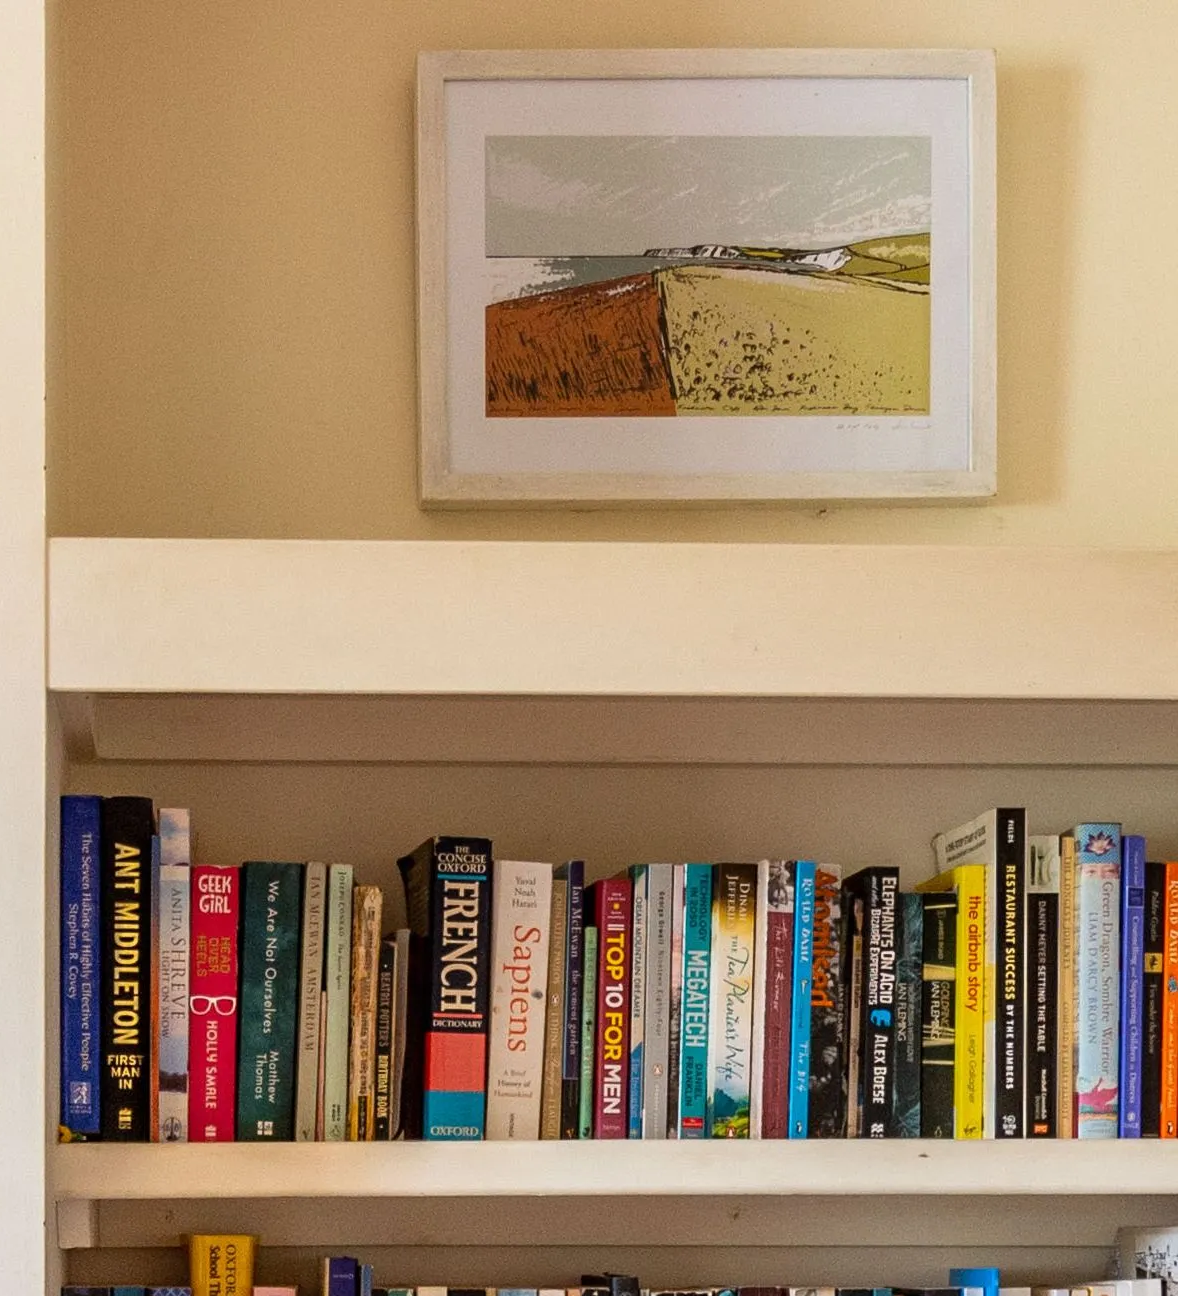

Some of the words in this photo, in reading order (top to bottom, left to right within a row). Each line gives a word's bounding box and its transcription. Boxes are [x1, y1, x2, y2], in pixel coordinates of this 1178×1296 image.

[114, 843, 141, 894] ANT
[437, 852, 487, 864] CONCISE
[437, 863, 487, 874] OXFORD
[198, 875, 232, 894] GEEK
[268, 880, 280, 903] We
[1102, 880, 1113, 918] Green
[171, 888, 182, 932] ANITA
[267, 910, 278, 933] Are
[880, 876, 896, 948] ELEPHANTS
[969, 895, 982, 921] the
[1005, 865, 1017, 944] RESTAURANT
[67, 903, 79, 949] Stephen
[195, 935, 207, 977] HEELS
[208, 937, 219, 973] OVER
[219, 936, 230, 974] HEAD
[266, 938, 278, 962] Not
[440, 880, 481, 1013] FRENCH
[607, 933, 624, 981] TOP
[727, 948, 750, 979] Tea
[880, 950, 895, 970] ON
[968, 924, 980, 973] airbnb
[1100, 921, 1114, 973] Dragon,
[67, 966, 79, 999] Covey
[112, 902, 140, 1045] MIDDLETON
[161, 951, 171, 984] LIGHT
[170, 936, 186, 1021] SHREVE
[1005, 947, 1016, 1000] SUCCESS
[161, 987, 170, 1003] ON
[263, 967, 277, 1034] Ourselves
[502, 925, 541, 1052] Sapiens
[606, 983, 624, 1008] 10
[685, 950, 708, 1048] MEGATECH
[880, 973, 894, 1004] ACID
[965, 976, 980, 1012] story
[1100, 980, 1113, 1023] Sombre
[160, 1006, 170, 1039] SNOW
[432, 1019, 483, 1029] DICTIONARY
[1005, 1020, 1014, 1039] THE
[1006, 1004, 1015, 1017] BY
[205, 1020, 218, 1063] HOLLY
[604, 1012, 623, 1060] FOR
[874, 1035, 888, 1064] ALEX
[1101, 1026, 1113, 1074] Warrior
[107, 1055, 145, 1065] FIRST
[111, 1067, 140, 1077] MAN
[255, 1052, 267, 1100] Thomas
[268, 1050, 280, 1104] Matthew
[716, 1043, 744, 1081] Wife
[1005, 1042, 1014, 1090] NUMBERS
[118, 1079, 133, 1089] IN
[204, 1067, 218, 1109] SMALE
[603, 1064, 622, 1114] MEN
[684, 1056, 694, 1107] FRANKLIN
[693, 1063, 703, 1100] DANIEL
[873, 1067, 886, 1105] BOESE
[430, 1125, 480, 1137] OXFORD
[209, 1244, 220, 1280] School
